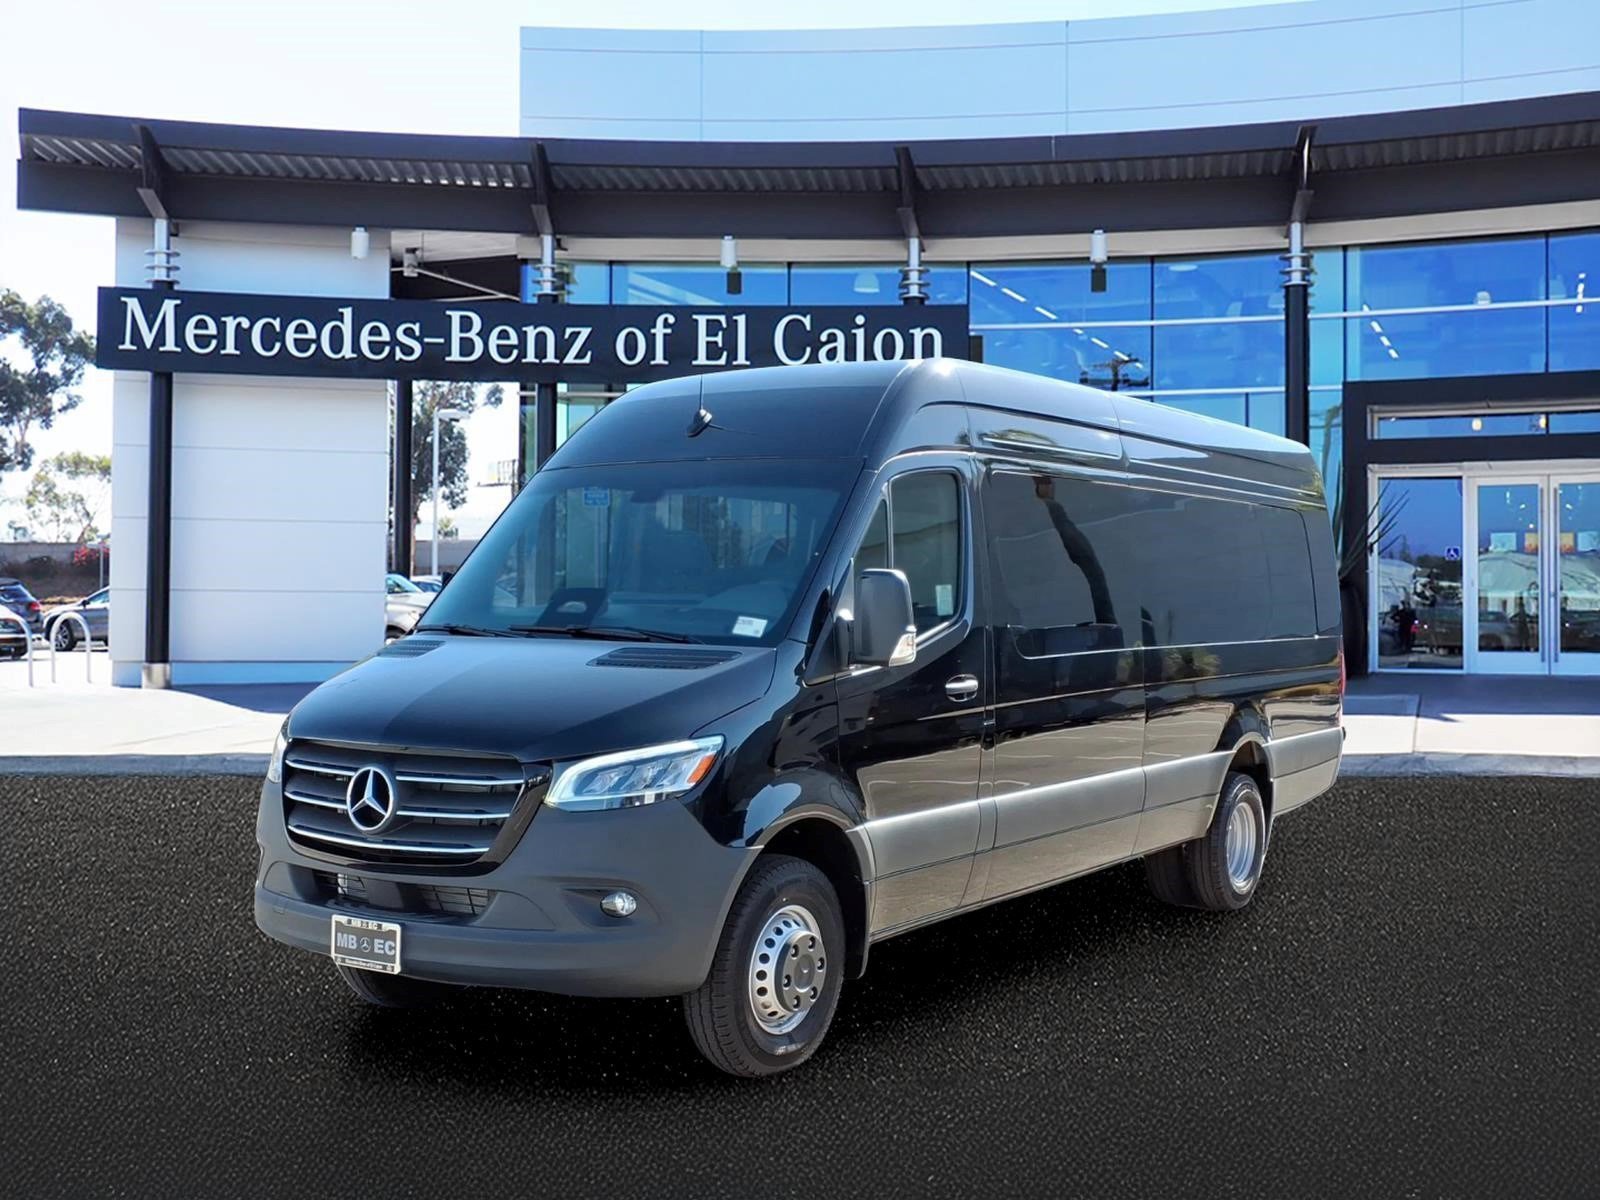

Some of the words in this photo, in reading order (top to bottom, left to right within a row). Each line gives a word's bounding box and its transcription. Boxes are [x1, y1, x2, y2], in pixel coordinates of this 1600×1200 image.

[117, 296, 592, 366] Mercedes-Benz
[615, 312, 676, 366] of
[691, 313, 751, 366] El
[336, 932, 357, 950] MB
[374, 938, 395, 956] EC
